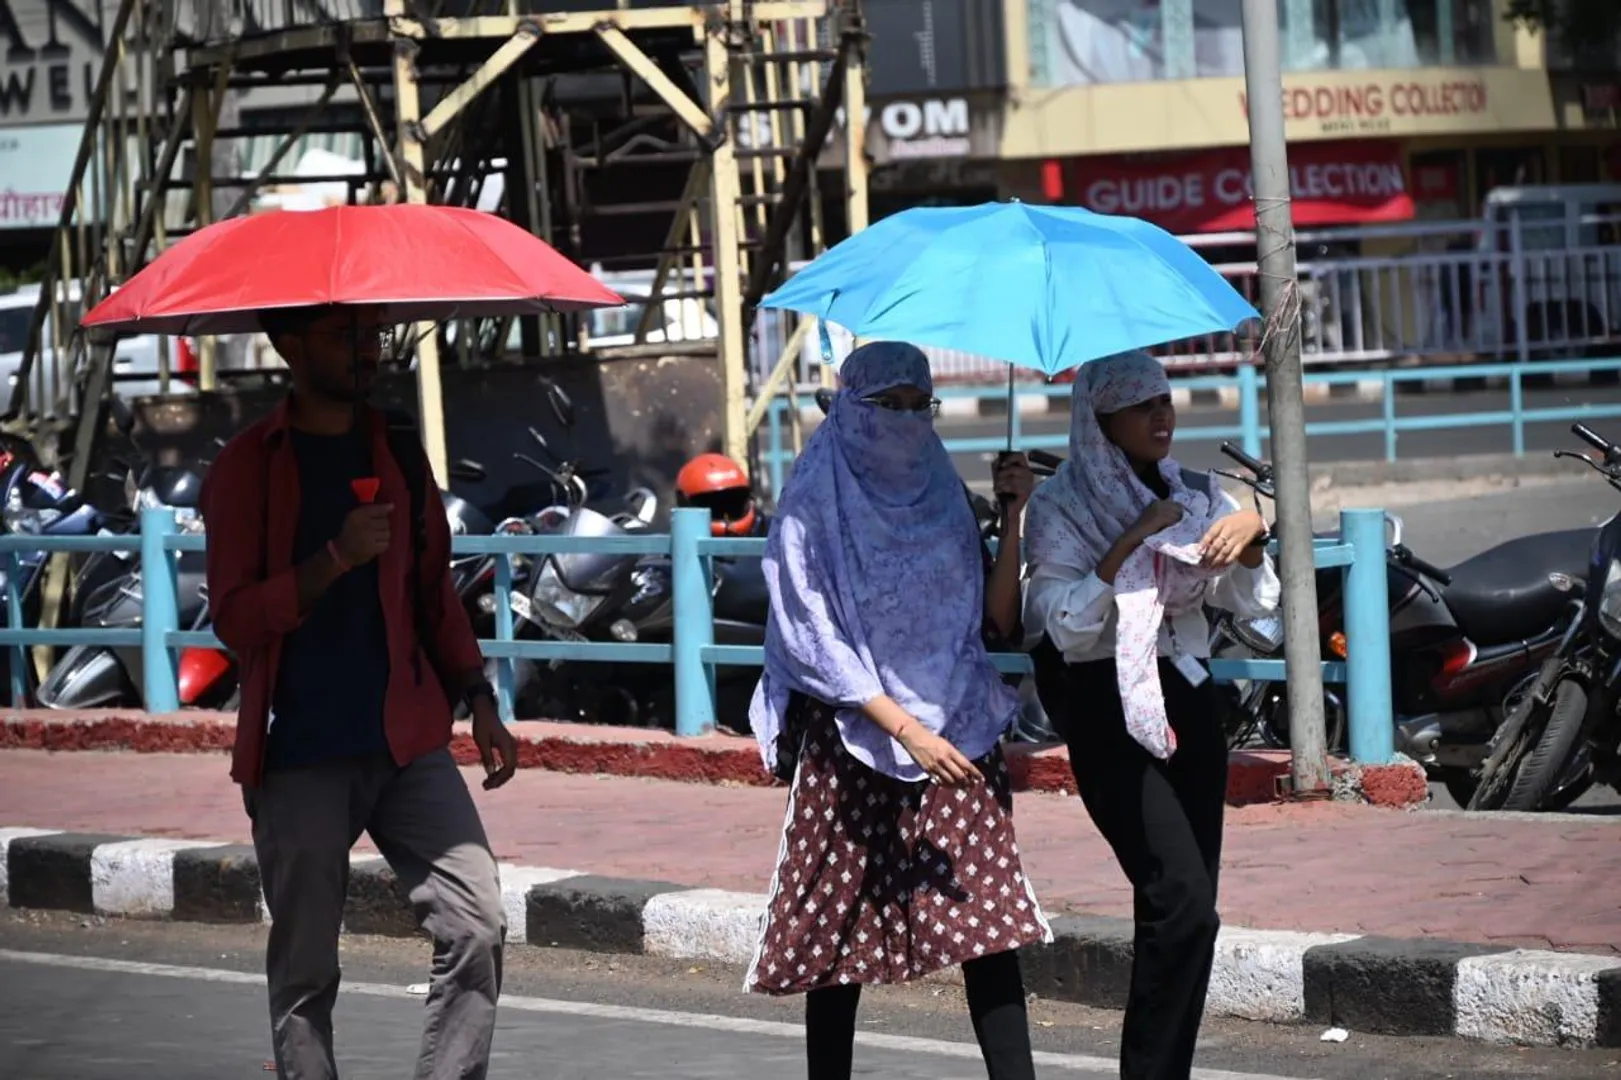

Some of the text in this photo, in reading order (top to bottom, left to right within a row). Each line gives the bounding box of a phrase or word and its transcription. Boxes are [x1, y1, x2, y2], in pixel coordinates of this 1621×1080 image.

[1239, 84, 1383, 119] DDING
[1088, 163, 1404, 212] GUIDE CLECTION
